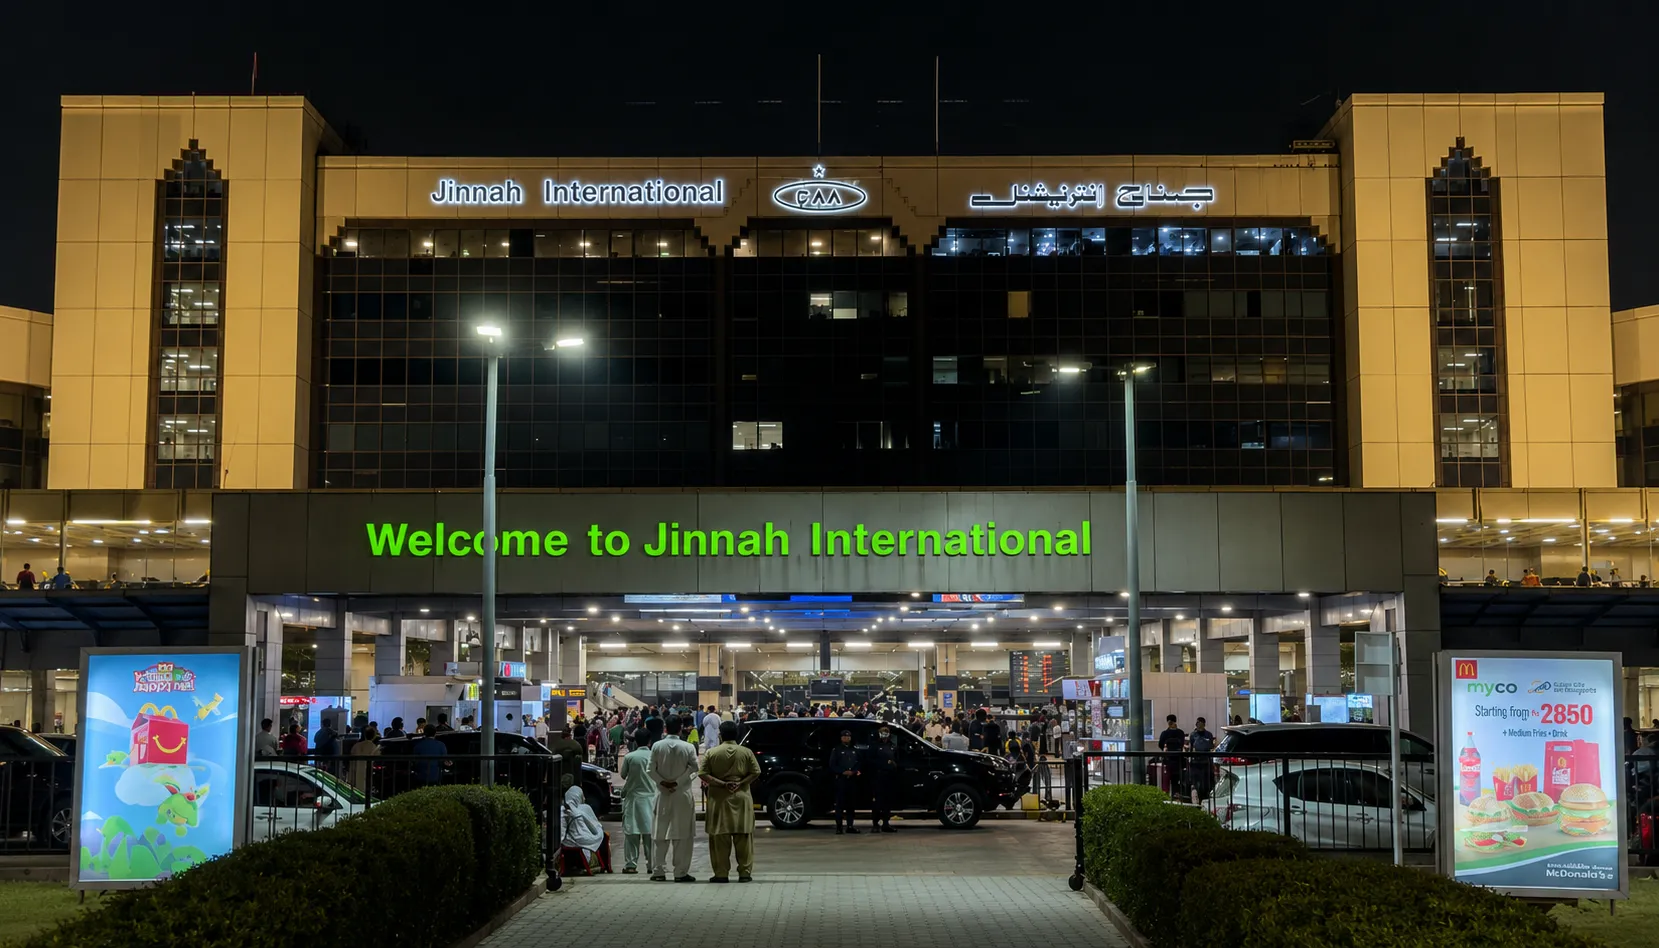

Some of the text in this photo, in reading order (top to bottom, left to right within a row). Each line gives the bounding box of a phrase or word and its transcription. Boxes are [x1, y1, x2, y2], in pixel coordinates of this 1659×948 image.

[430, 179, 725, 205] Jinnah International
[366, 519, 1091, 557] Welcome to Jinnah International
[1467, 682, 1518, 697] myco
[1475, 704, 1508, 720] Starting
[1509, 705, 1530, 721] from
[1540, 703, 1594, 725] 2850
[1508, 728, 1532, 738] Medium
[1533, 728, 1548, 738] Fries
